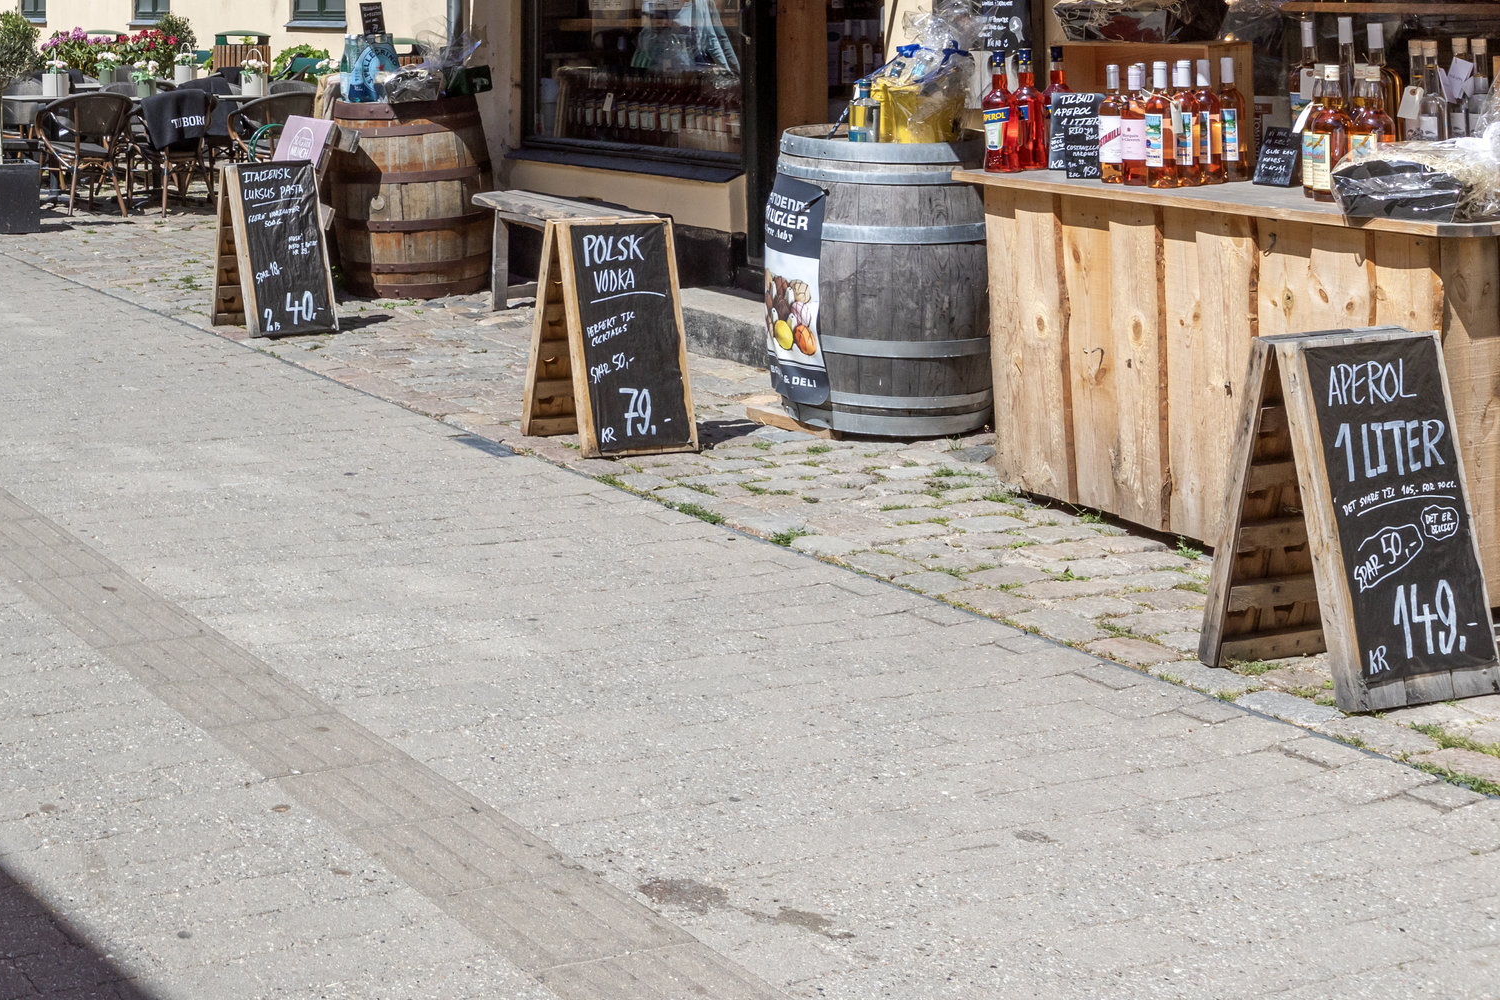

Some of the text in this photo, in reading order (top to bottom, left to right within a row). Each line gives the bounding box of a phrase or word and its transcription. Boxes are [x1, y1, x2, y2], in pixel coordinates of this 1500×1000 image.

[1053, 106, 1092, 117] APEROL
[242, 168, 292, 184] ITALIENSK
[1050, 160, 1065, 169] KR
[244, 184, 304, 201] LUKSUS PASTA
[583, 234, 644, 267] POLSK
[255, 269, 269, 285] SPAR
[593, 267, 635, 294] VODKA
[586, 315, 618, 339] PERFEKT
[590, 362, 612, 385] SPAR
[791, 375, 817, 388] DELI
[1327, 357, 1418, 408] APEROL
[601, 426, 618, 443] KR
[1334, 418, 1446, 483] 1 LITER
[1342, 499, 1358, 517] DET
[1422, 483, 1436, 493] FOR
[1424, 511, 1453, 525] DET ER
[1353, 553, 1385, 590] SPAR
[1368, 645, 1391, 676] KR
